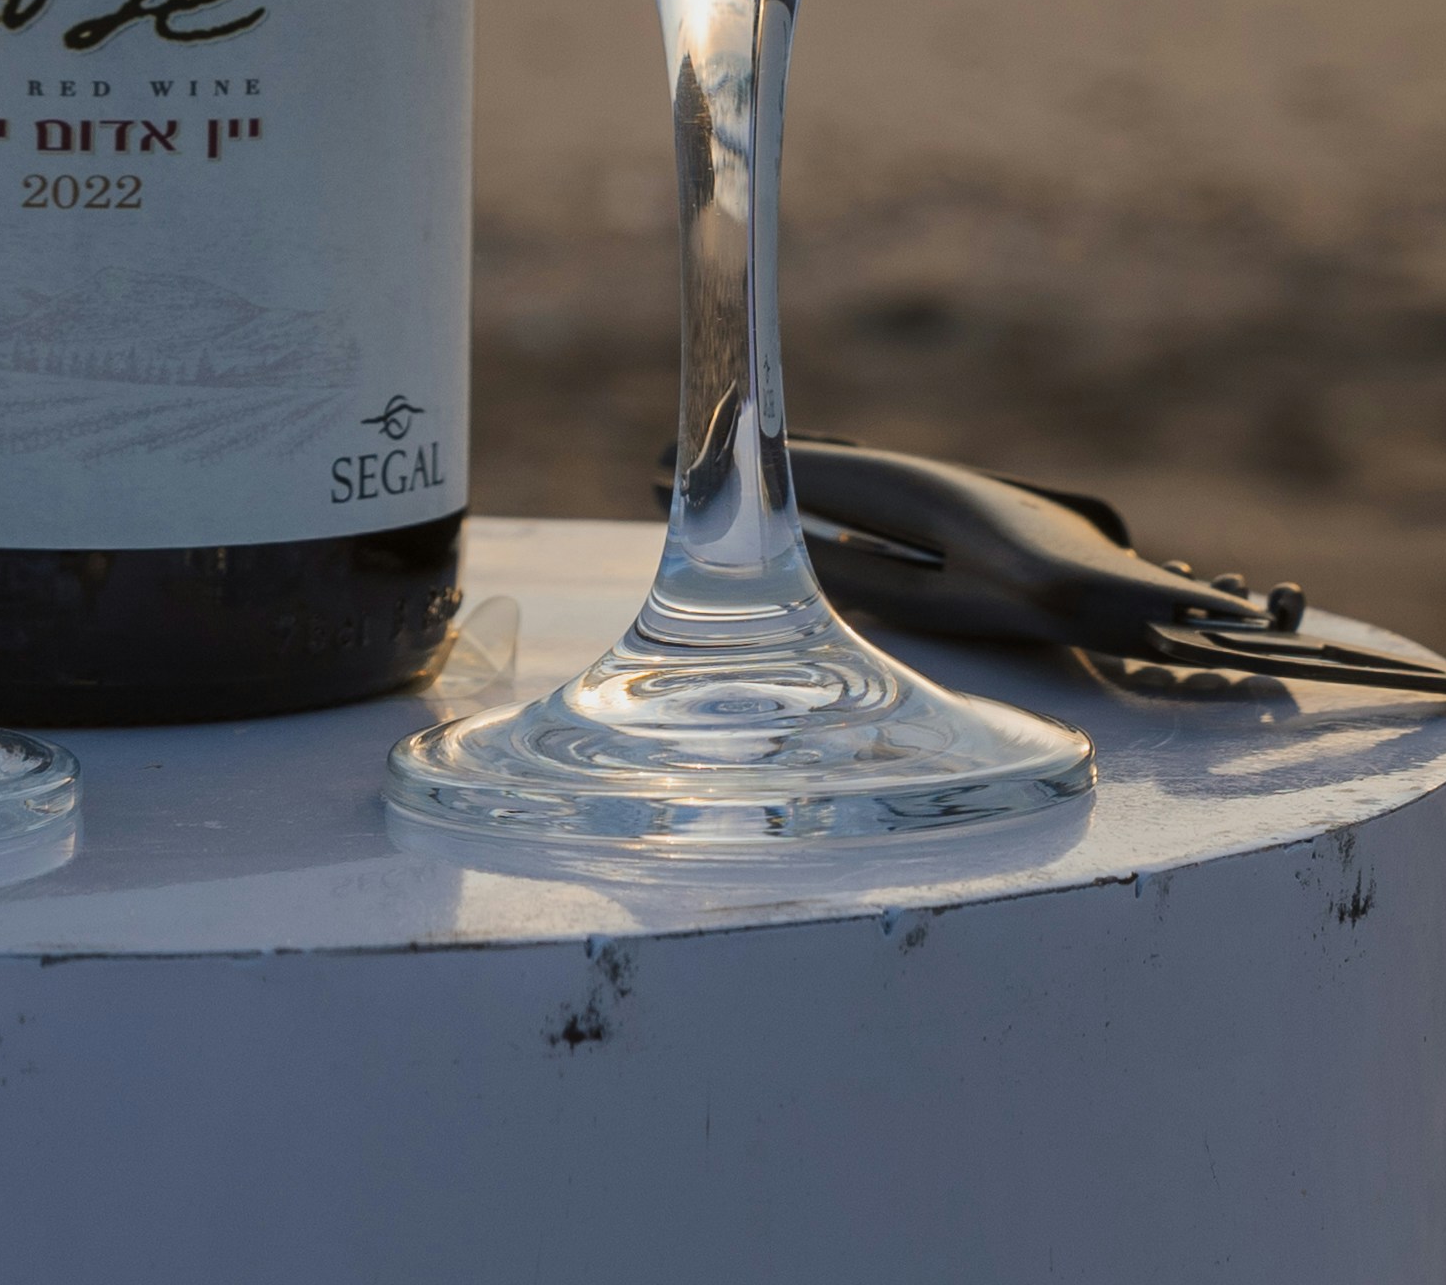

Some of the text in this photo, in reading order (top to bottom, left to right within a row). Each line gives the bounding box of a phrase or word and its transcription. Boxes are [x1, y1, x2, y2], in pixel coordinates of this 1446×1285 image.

[26, 79, 112, 98] RED
[149, 78, 261, 98] WINE
[34, 118, 180, 153] אדום
[206, 117, 262, 160] יין
[20, 173, 144, 210] 2022
[330, 442, 445, 505] SEGAL
